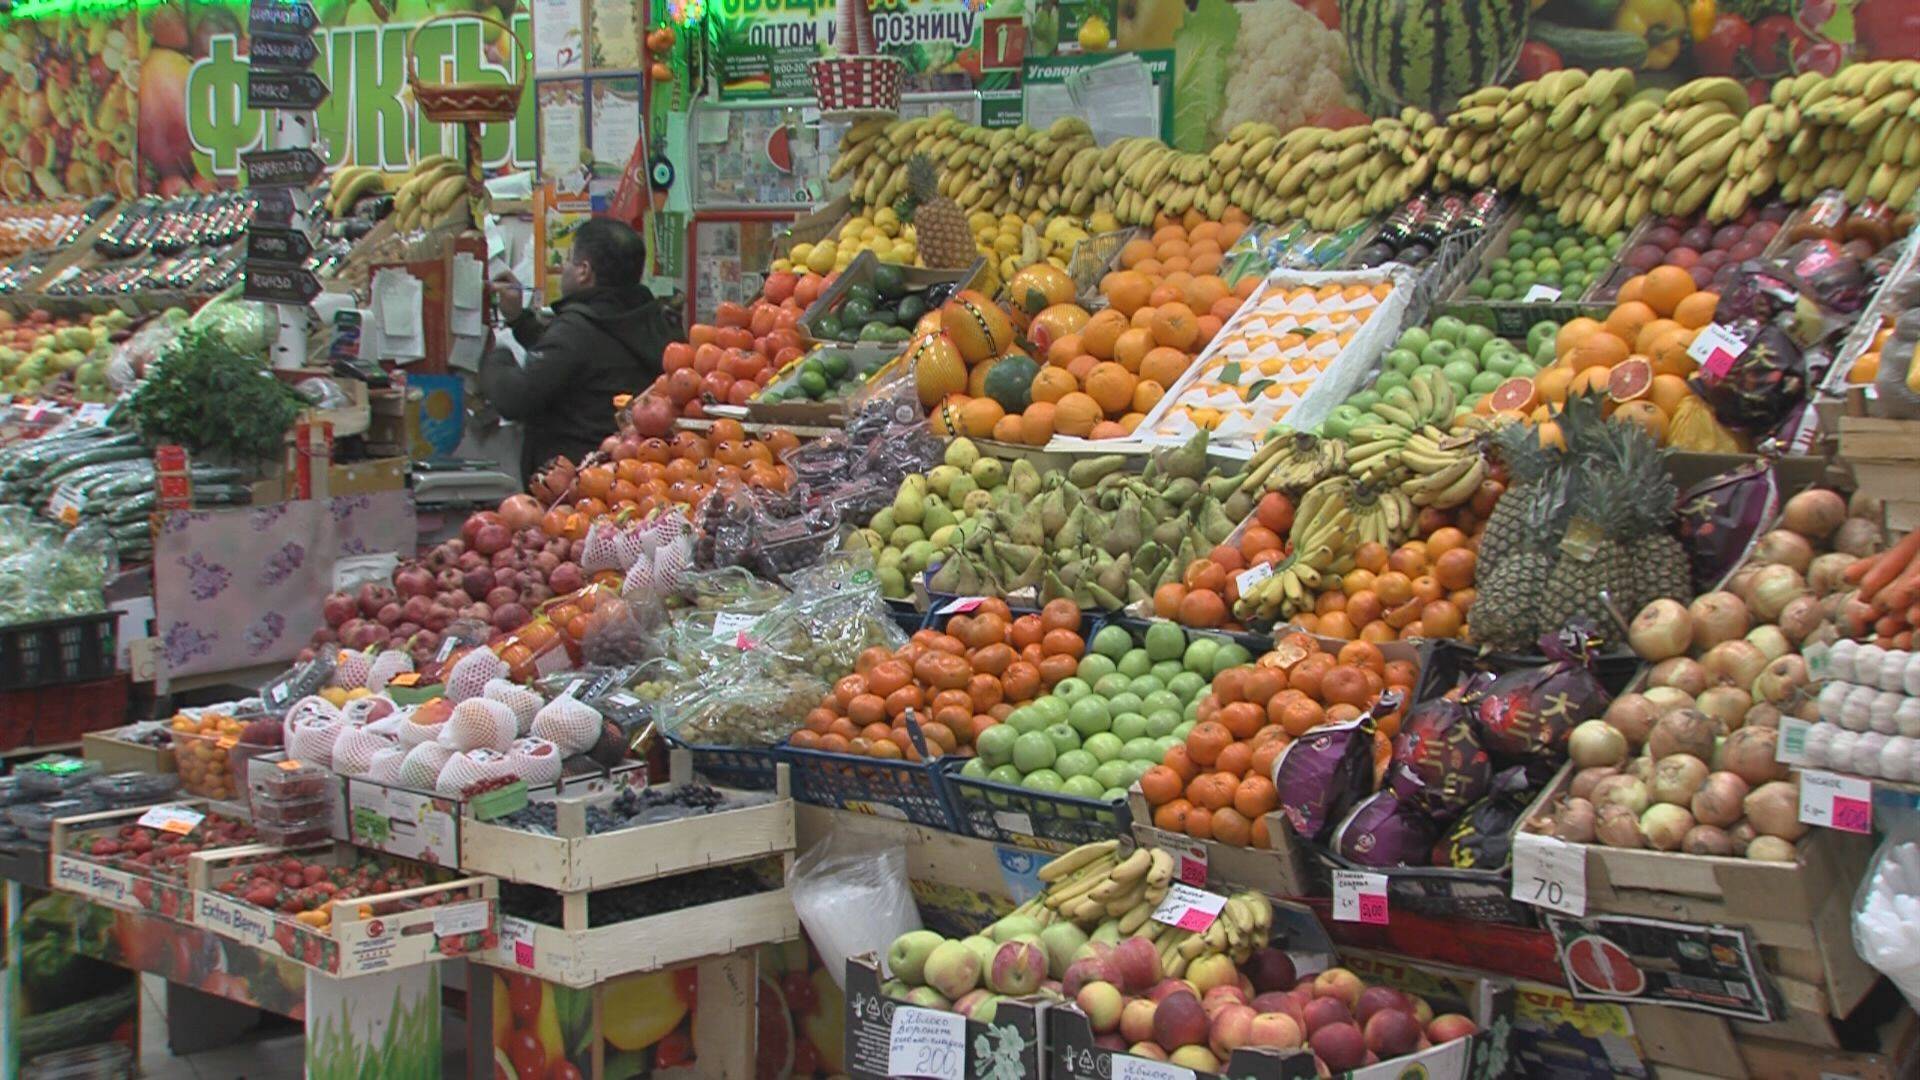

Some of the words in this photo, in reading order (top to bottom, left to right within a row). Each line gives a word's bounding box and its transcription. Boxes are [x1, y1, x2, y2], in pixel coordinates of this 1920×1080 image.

[875, 12, 977, 45] РОЗНИЦУ
[186, 14, 537, 175] ФУКТЫ
[59, 860, 90, 884] Extra
[92, 869, 126, 900] Berry
[1533, 876, 1563, 905] 70
[202, 899, 231, 924] Extra
[233, 910, 268, 944] Berry
